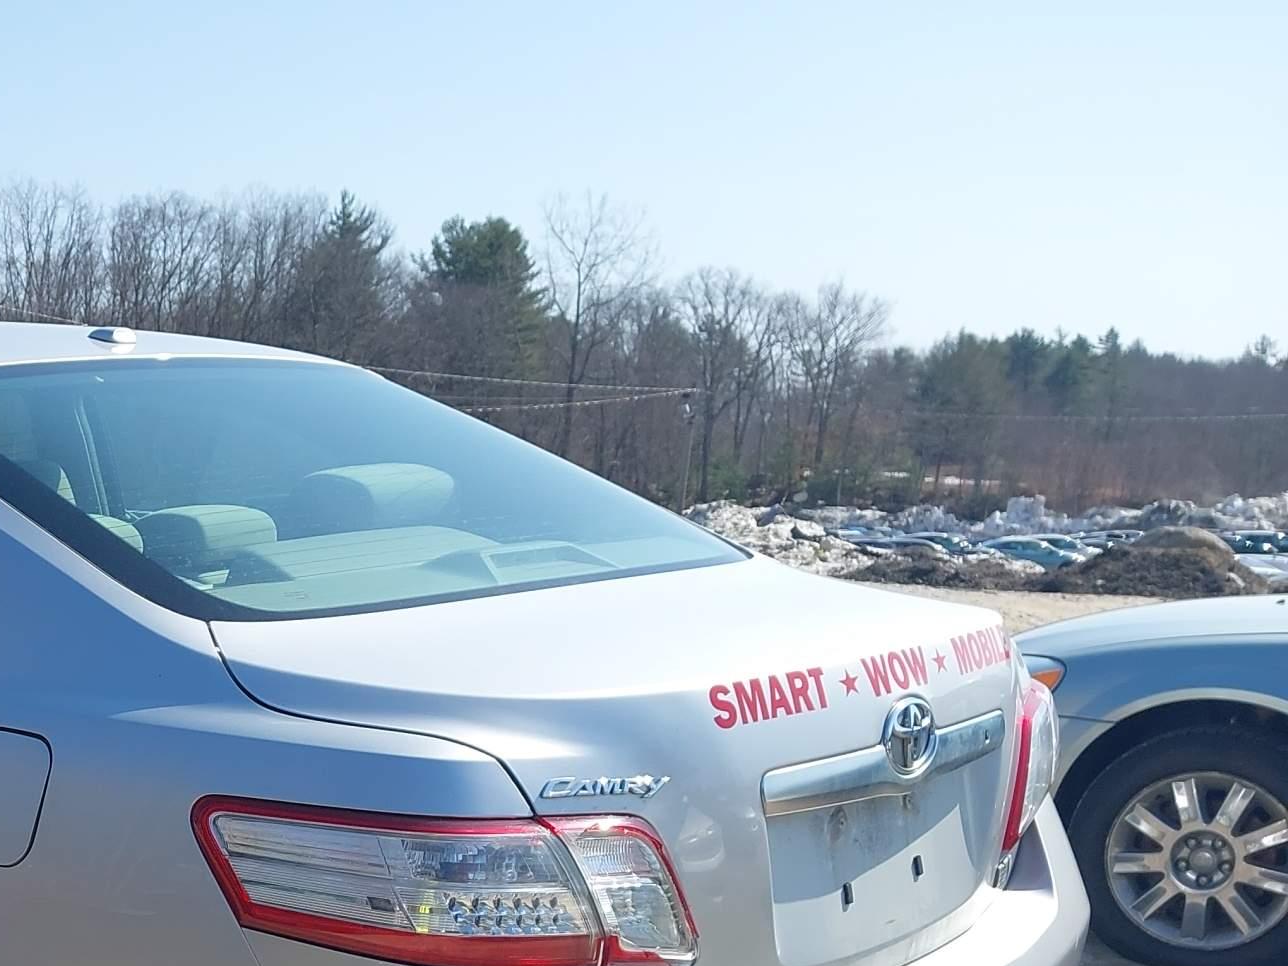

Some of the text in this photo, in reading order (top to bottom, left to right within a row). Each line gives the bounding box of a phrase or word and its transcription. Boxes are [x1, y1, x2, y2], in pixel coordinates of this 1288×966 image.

[709, 667, 829, 729] SMART
[860, 646, 928, 697] WOW
[539, 774, 671, 799] CAMRY
